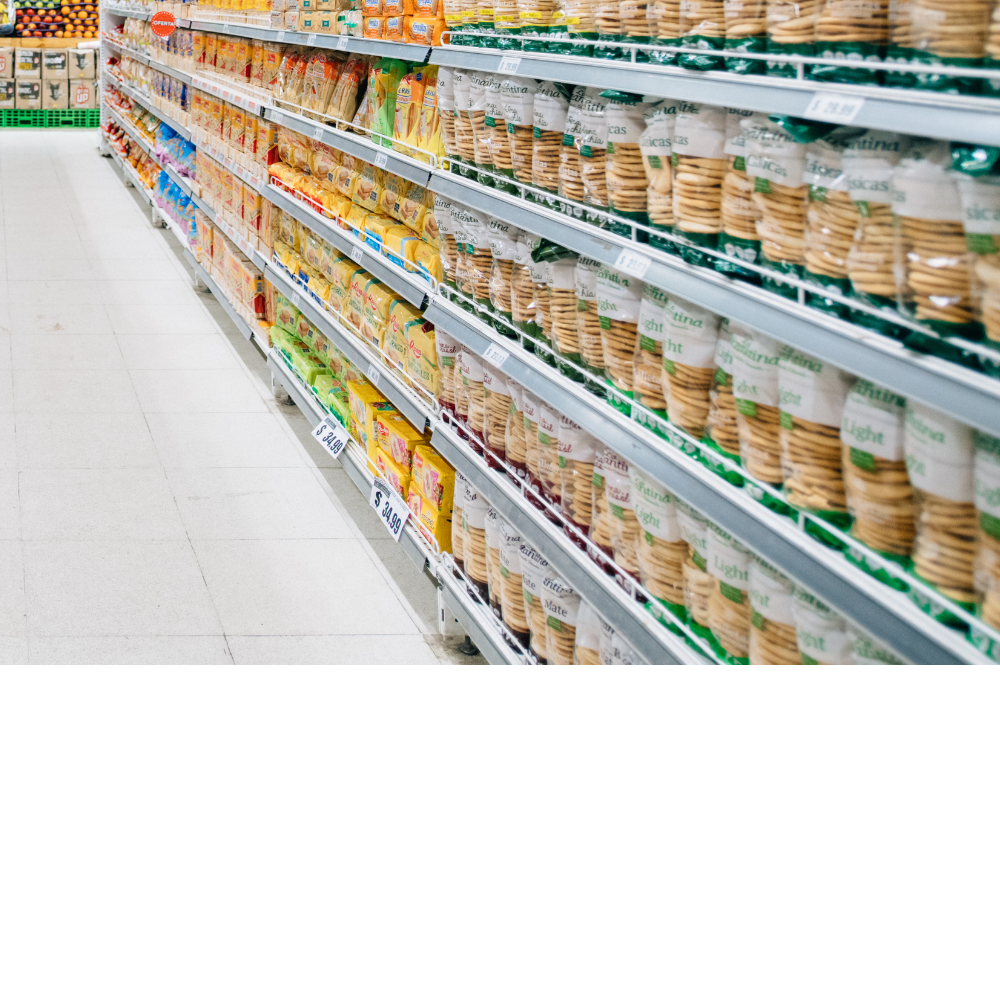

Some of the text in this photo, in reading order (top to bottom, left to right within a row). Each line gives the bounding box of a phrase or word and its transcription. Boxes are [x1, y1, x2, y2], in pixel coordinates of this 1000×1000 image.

[316, 425, 344, 454] $ 34.99
[374, 491, 402, 534] $ 34.99
[543, 600, 568, 617] Mate
